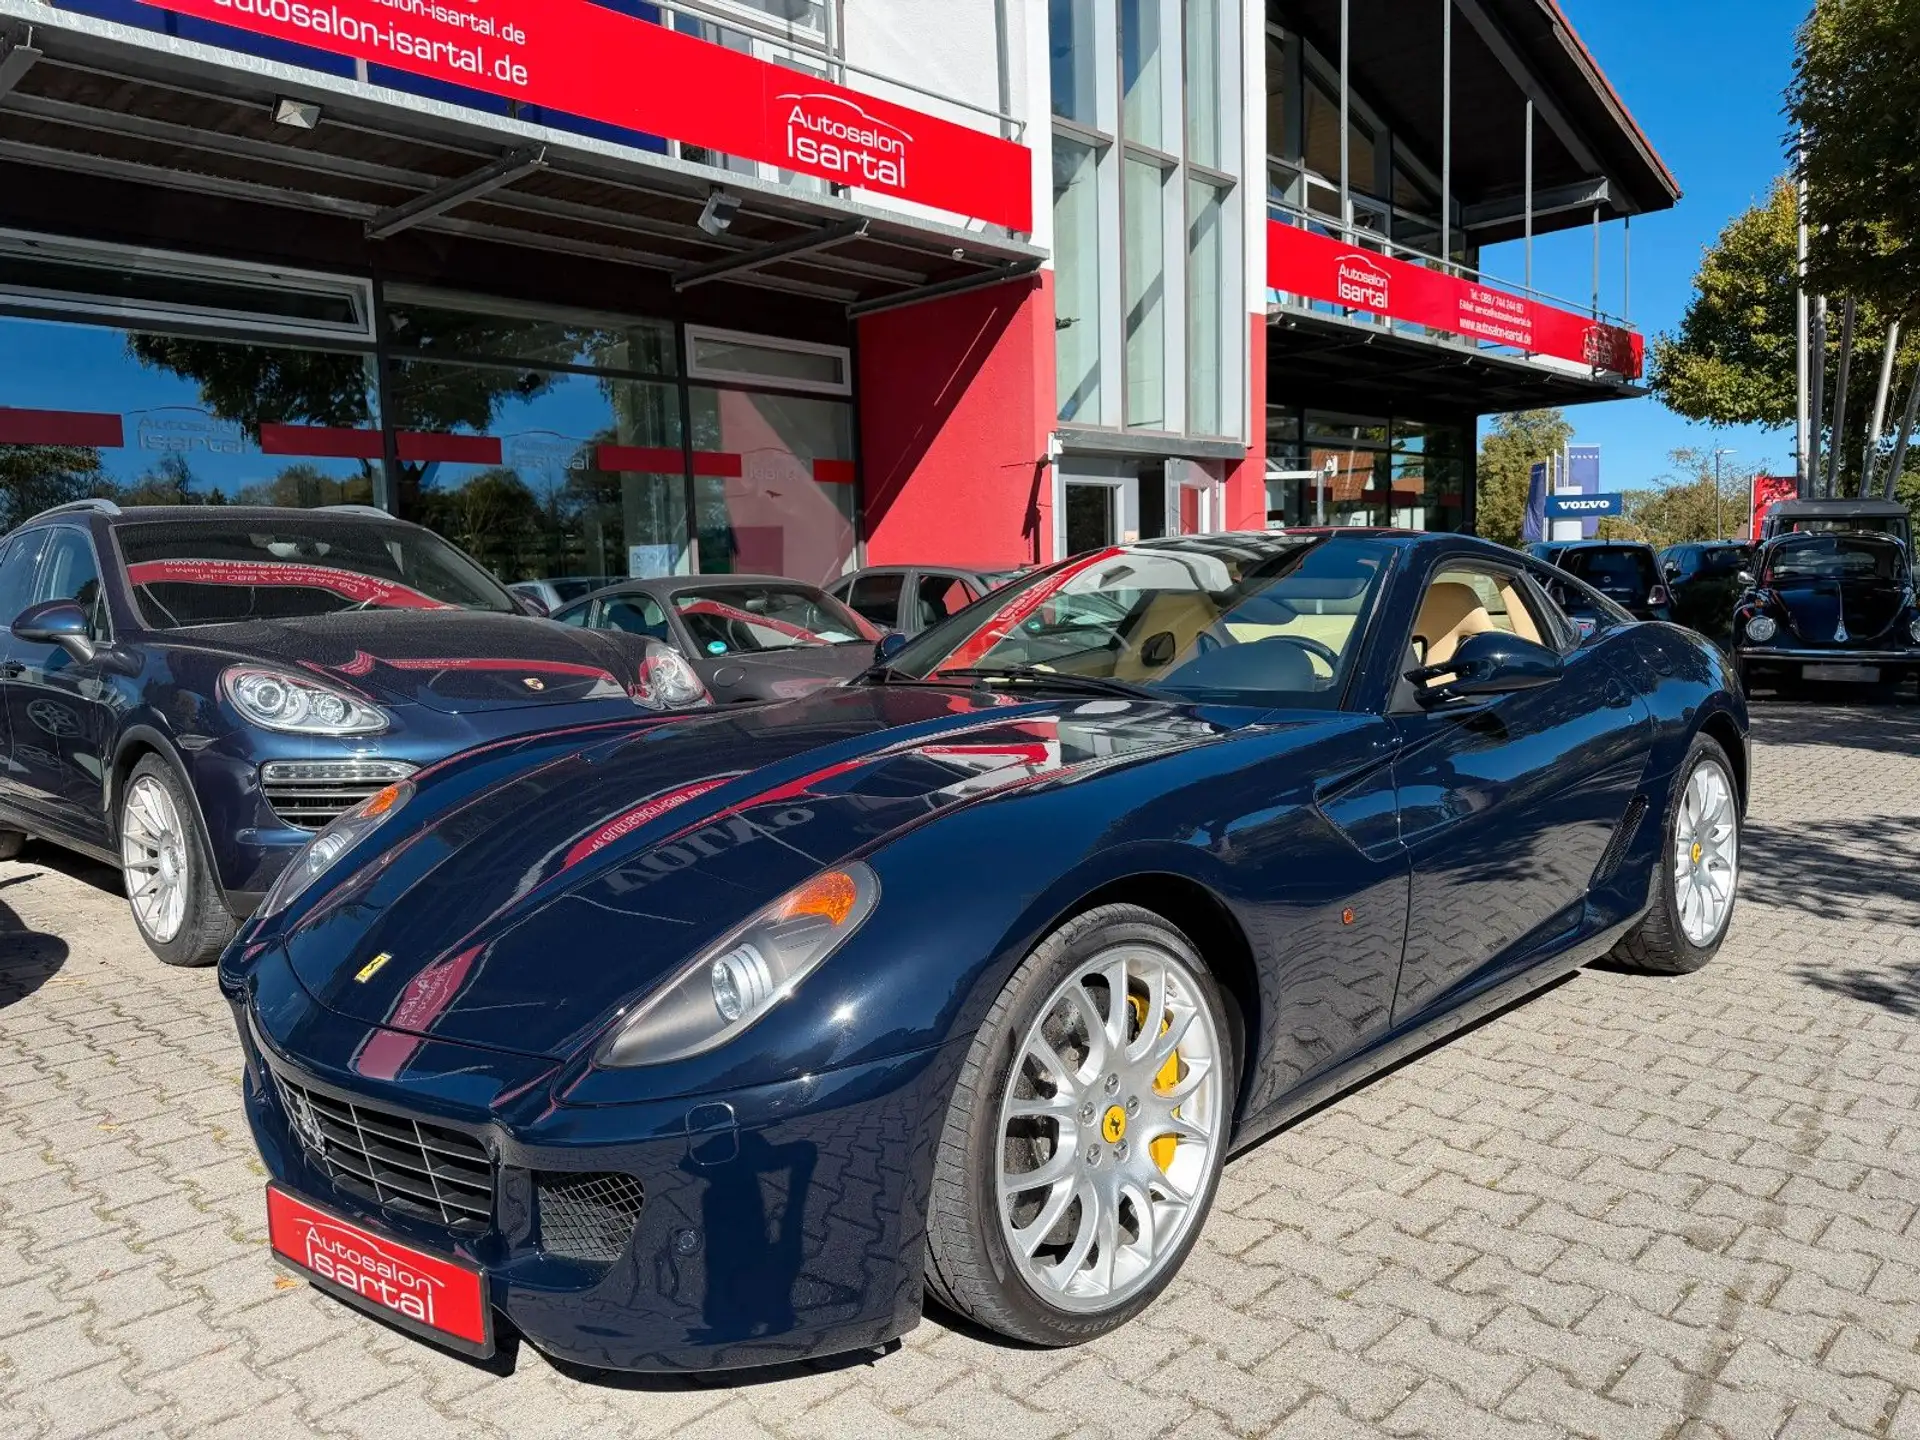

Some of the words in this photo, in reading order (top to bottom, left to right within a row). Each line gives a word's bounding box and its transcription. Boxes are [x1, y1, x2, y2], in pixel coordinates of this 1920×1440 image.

[787, 105, 905, 156] Autosalon
[787, 124, 906, 188] Isartal
[1338, 276, 1388, 309] Isartal
[1339, 263, 1388, 288] Autosalon
[1558, 500, 1610, 510] VOLVO
[306, 1225, 433, 1296] Autosalon
[306, 1240, 435, 1325] Isartal
